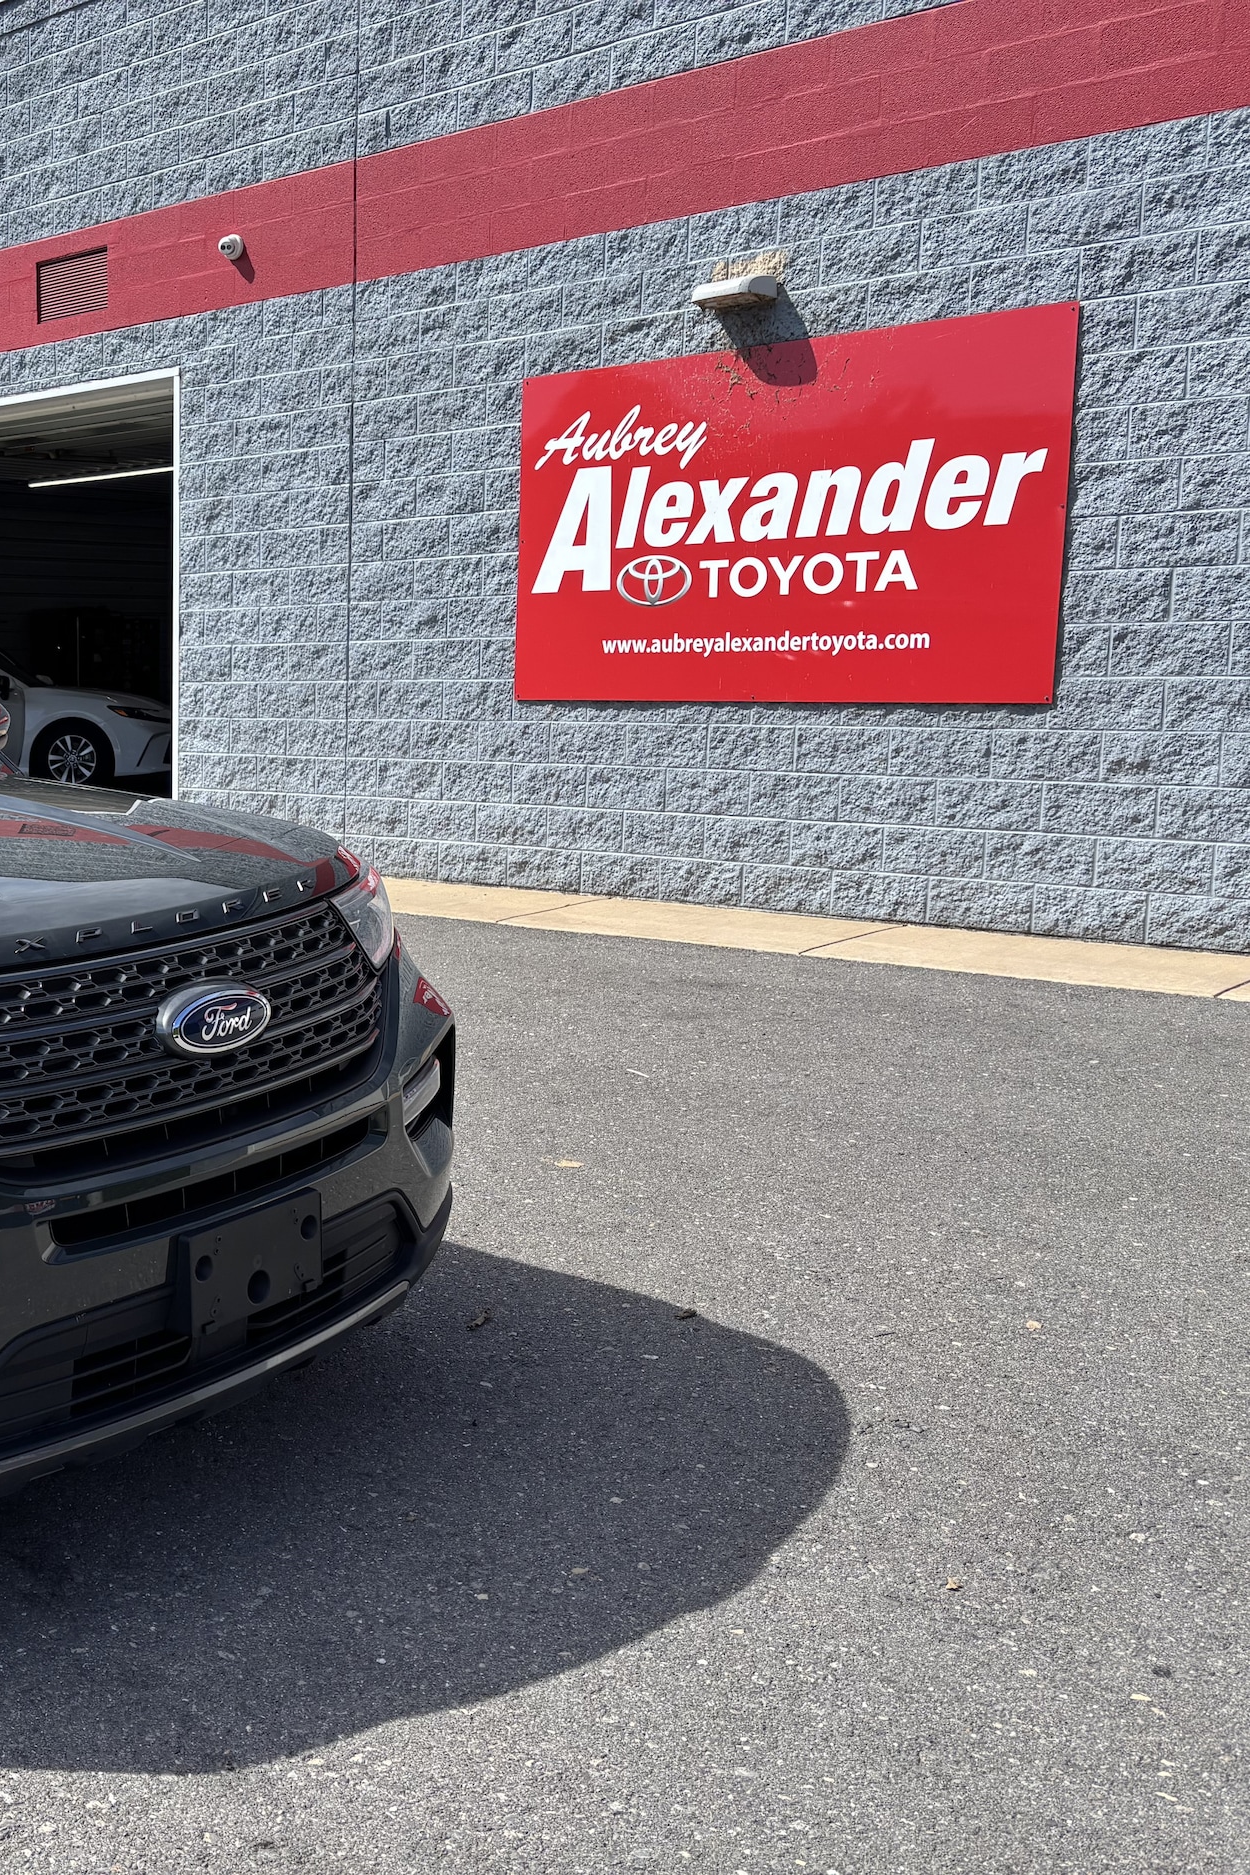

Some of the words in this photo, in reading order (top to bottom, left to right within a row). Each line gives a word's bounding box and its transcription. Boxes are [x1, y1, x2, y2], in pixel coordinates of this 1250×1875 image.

[535, 404, 707, 470] Aubrey
[532, 438, 1049, 594] Alexander
[699, 549, 918, 598] TOYOTA
[601, 630, 931, 658] www.aubreyalexandertoyota.com
[202, 1002, 252, 1041] Ford
